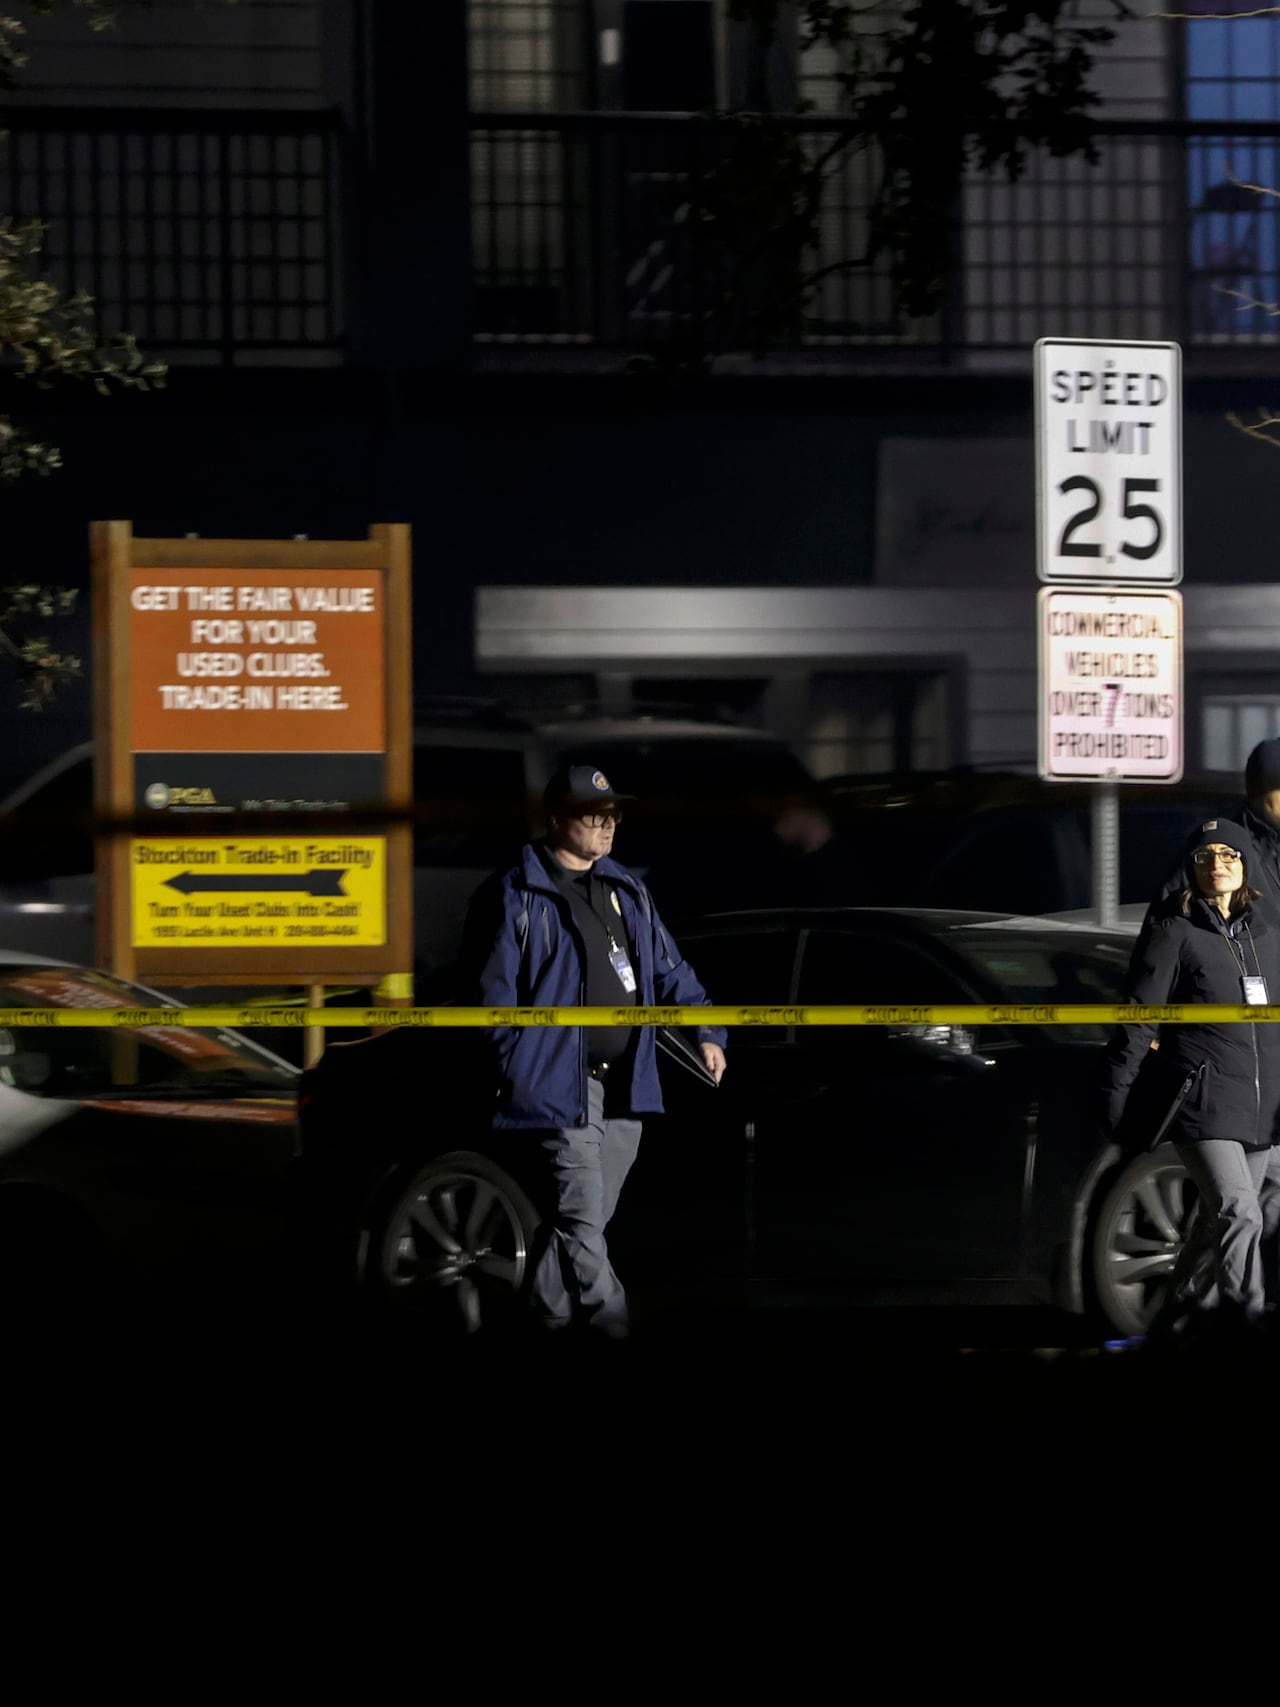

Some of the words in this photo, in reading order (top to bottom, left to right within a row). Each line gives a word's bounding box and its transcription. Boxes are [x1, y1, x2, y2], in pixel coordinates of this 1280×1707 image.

[1051, 370, 1167, 406] SPEED
[1067, 419, 1155, 454] LIMIT
[1057, 475, 1165, 560] 25
[131, 586, 182, 611] GET
[184, 587, 234, 611] THE
[237, 587, 293, 611] FAIR
[295, 587, 376, 612] VALUE
[191, 620, 244, 644] FOR
[246, 620, 317, 645] YOUR
[1049, 611, 1175, 640] COMMERCIAL
[177, 652, 244, 677] USED
[246, 653, 331, 677] CLUBS.
[1064, 651, 1160, 678] VEHICLES
[159, 685, 273, 710] TRADE-IN
[276, 686, 349, 710] HERE.
[1050, 690, 1100, 717] OVER
[1101, 683, 1123, 727] 7
[1124, 691, 1174, 718] TONS
[1055, 732, 1168, 759] PROHIBITED
[168, 786, 217, 804] PGA
[135, 845, 218, 865] Stockton
[222, 845, 301, 865] Trade-In
[306, 845, 374, 869] Facility
[148, 902, 179, 917] Turn
[184, 902, 213, 917] Your
[218, 902, 250, 917] Used
[254, 902, 290, 917] Clubs
